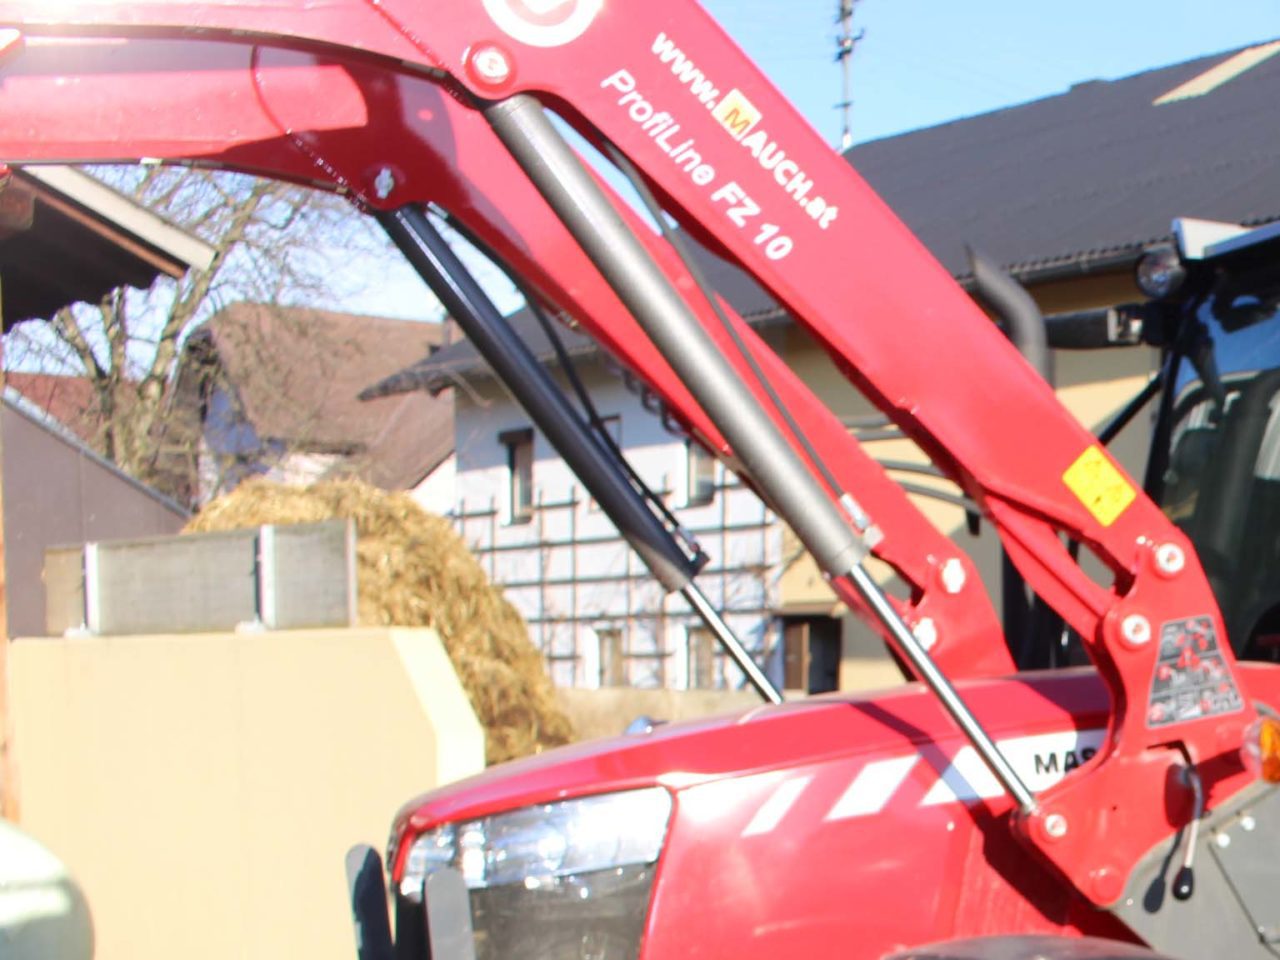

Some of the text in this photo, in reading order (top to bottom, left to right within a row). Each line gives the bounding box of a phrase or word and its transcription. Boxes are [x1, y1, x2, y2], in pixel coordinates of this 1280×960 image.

[600, 68, 794, 260] ProfiLine FZ 10
[651, 32, 839, 230] www.MAUCH.at
